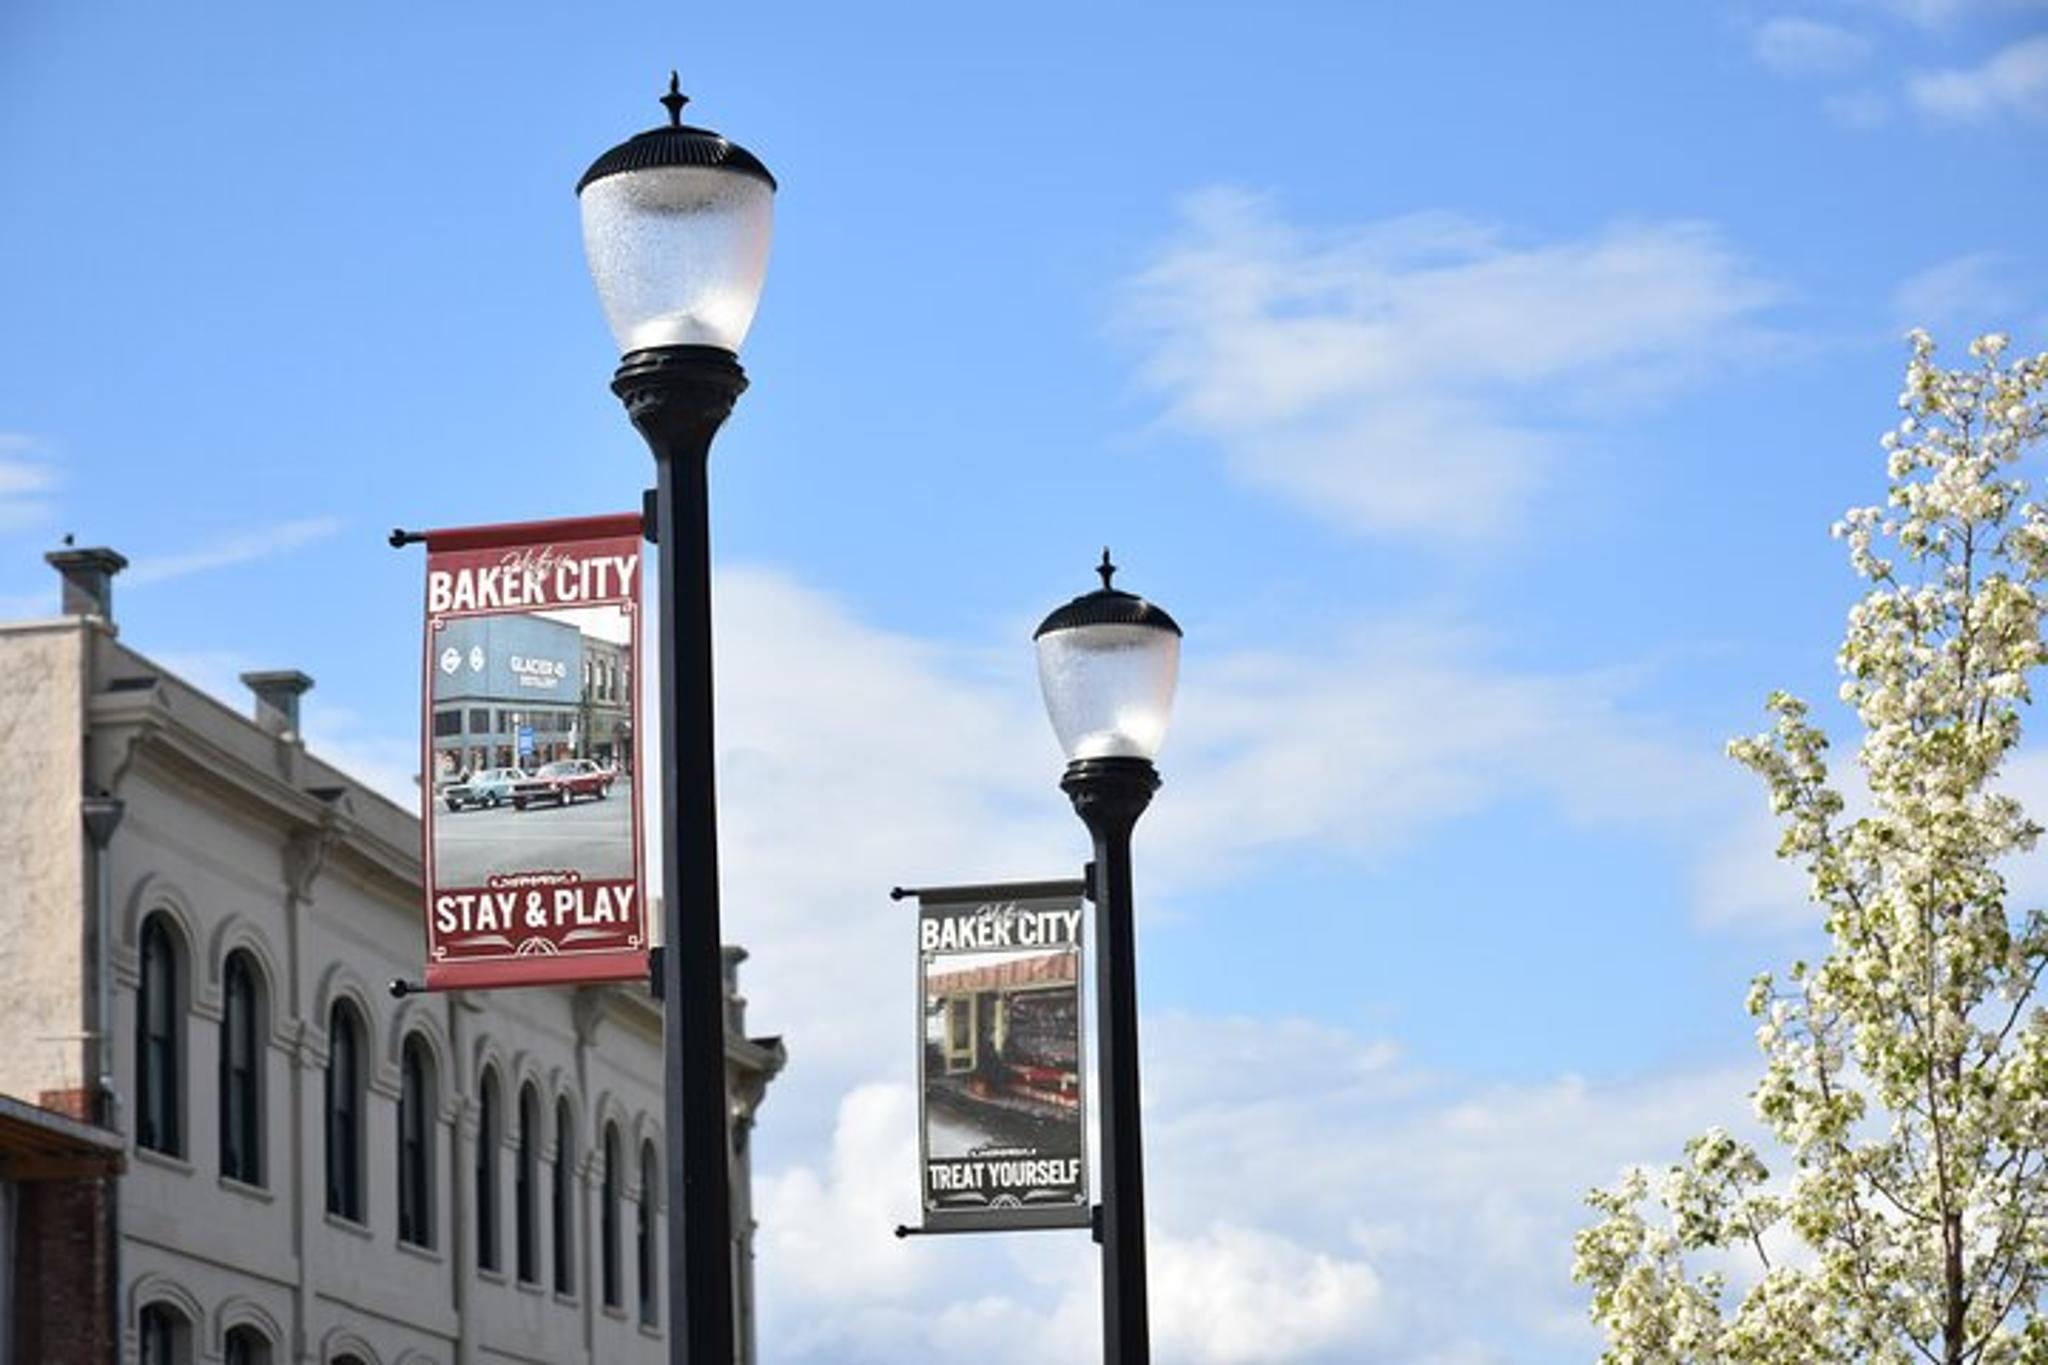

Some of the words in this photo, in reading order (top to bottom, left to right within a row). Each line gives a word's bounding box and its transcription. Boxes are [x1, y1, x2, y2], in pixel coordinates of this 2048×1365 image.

[428, 565, 545, 613] BAKER
[555, 554, 637, 601] CITY
[436, 892, 517, 933] STAY
[525, 891, 547, 928] &
[553, 885, 634, 926] PLAY
[921, 915, 1011, 950] BAKER
[1018, 909, 1082, 943] CITY
[929, 1162, 984, 1190] TREAT
[987, 1159, 1080, 1188] YOURSELF
